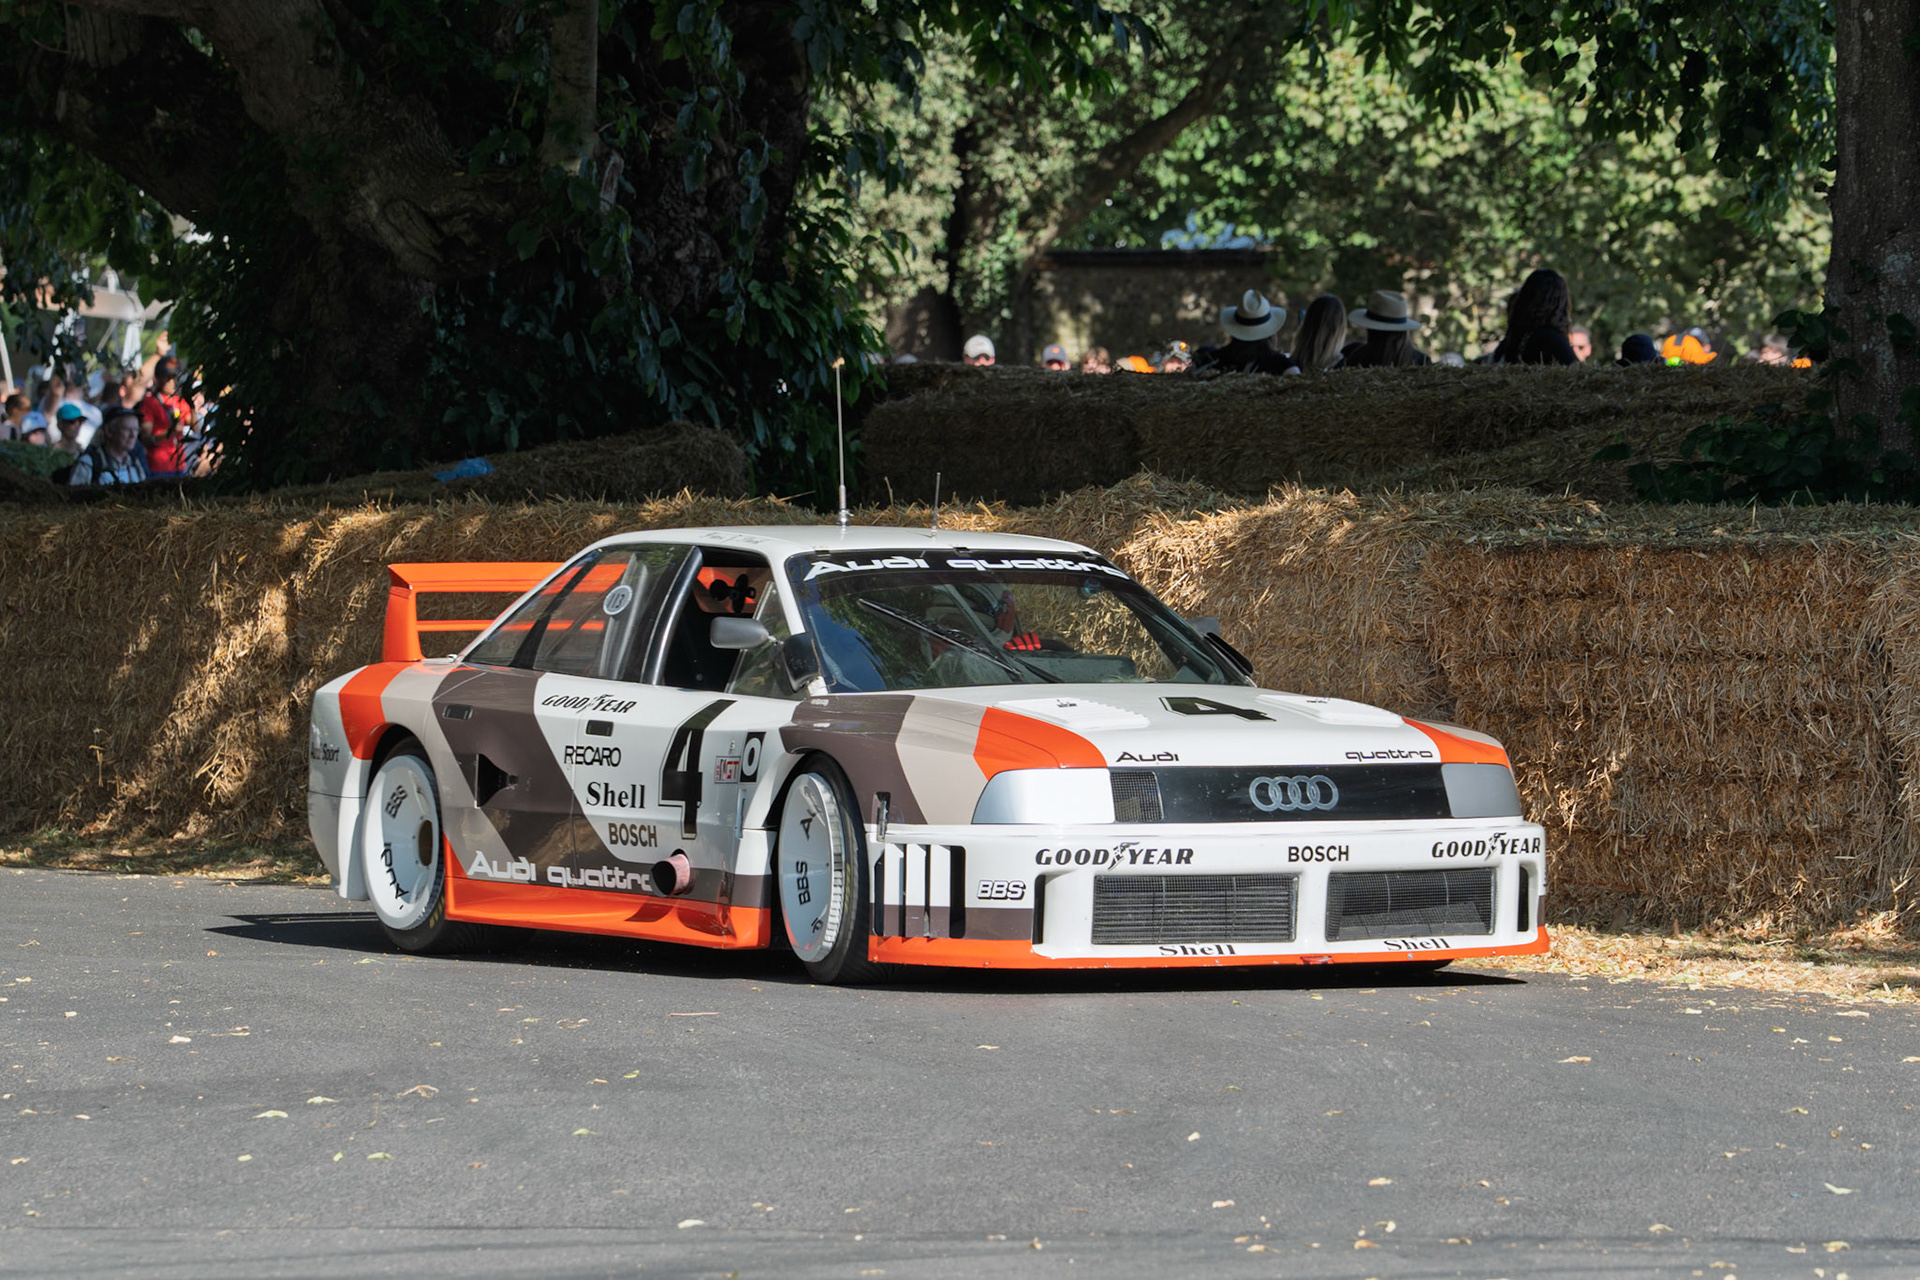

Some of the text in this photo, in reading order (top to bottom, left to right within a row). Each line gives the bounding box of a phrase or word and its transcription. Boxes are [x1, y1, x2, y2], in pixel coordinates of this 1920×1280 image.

[803, 556, 1131, 582] Audi quattro
[1159, 696, 1277, 722] 4
[564, 745, 622, 767] RECARO
[1115, 748, 1433, 763] Audi quattro
[658, 698, 737, 840] 4
[586, 781, 646, 809] Shell
[608, 822, 658, 847] BOSCH
[467, 850, 537, 882] Audi
[1288, 845, 1350, 863] BOSCH
[796, 860, 811, 906] BBS
[977, 880, 1026, 900] BBS
[1159, 944, 1236, 956] Shell
[1384, 937, 1452, 951] Shell
